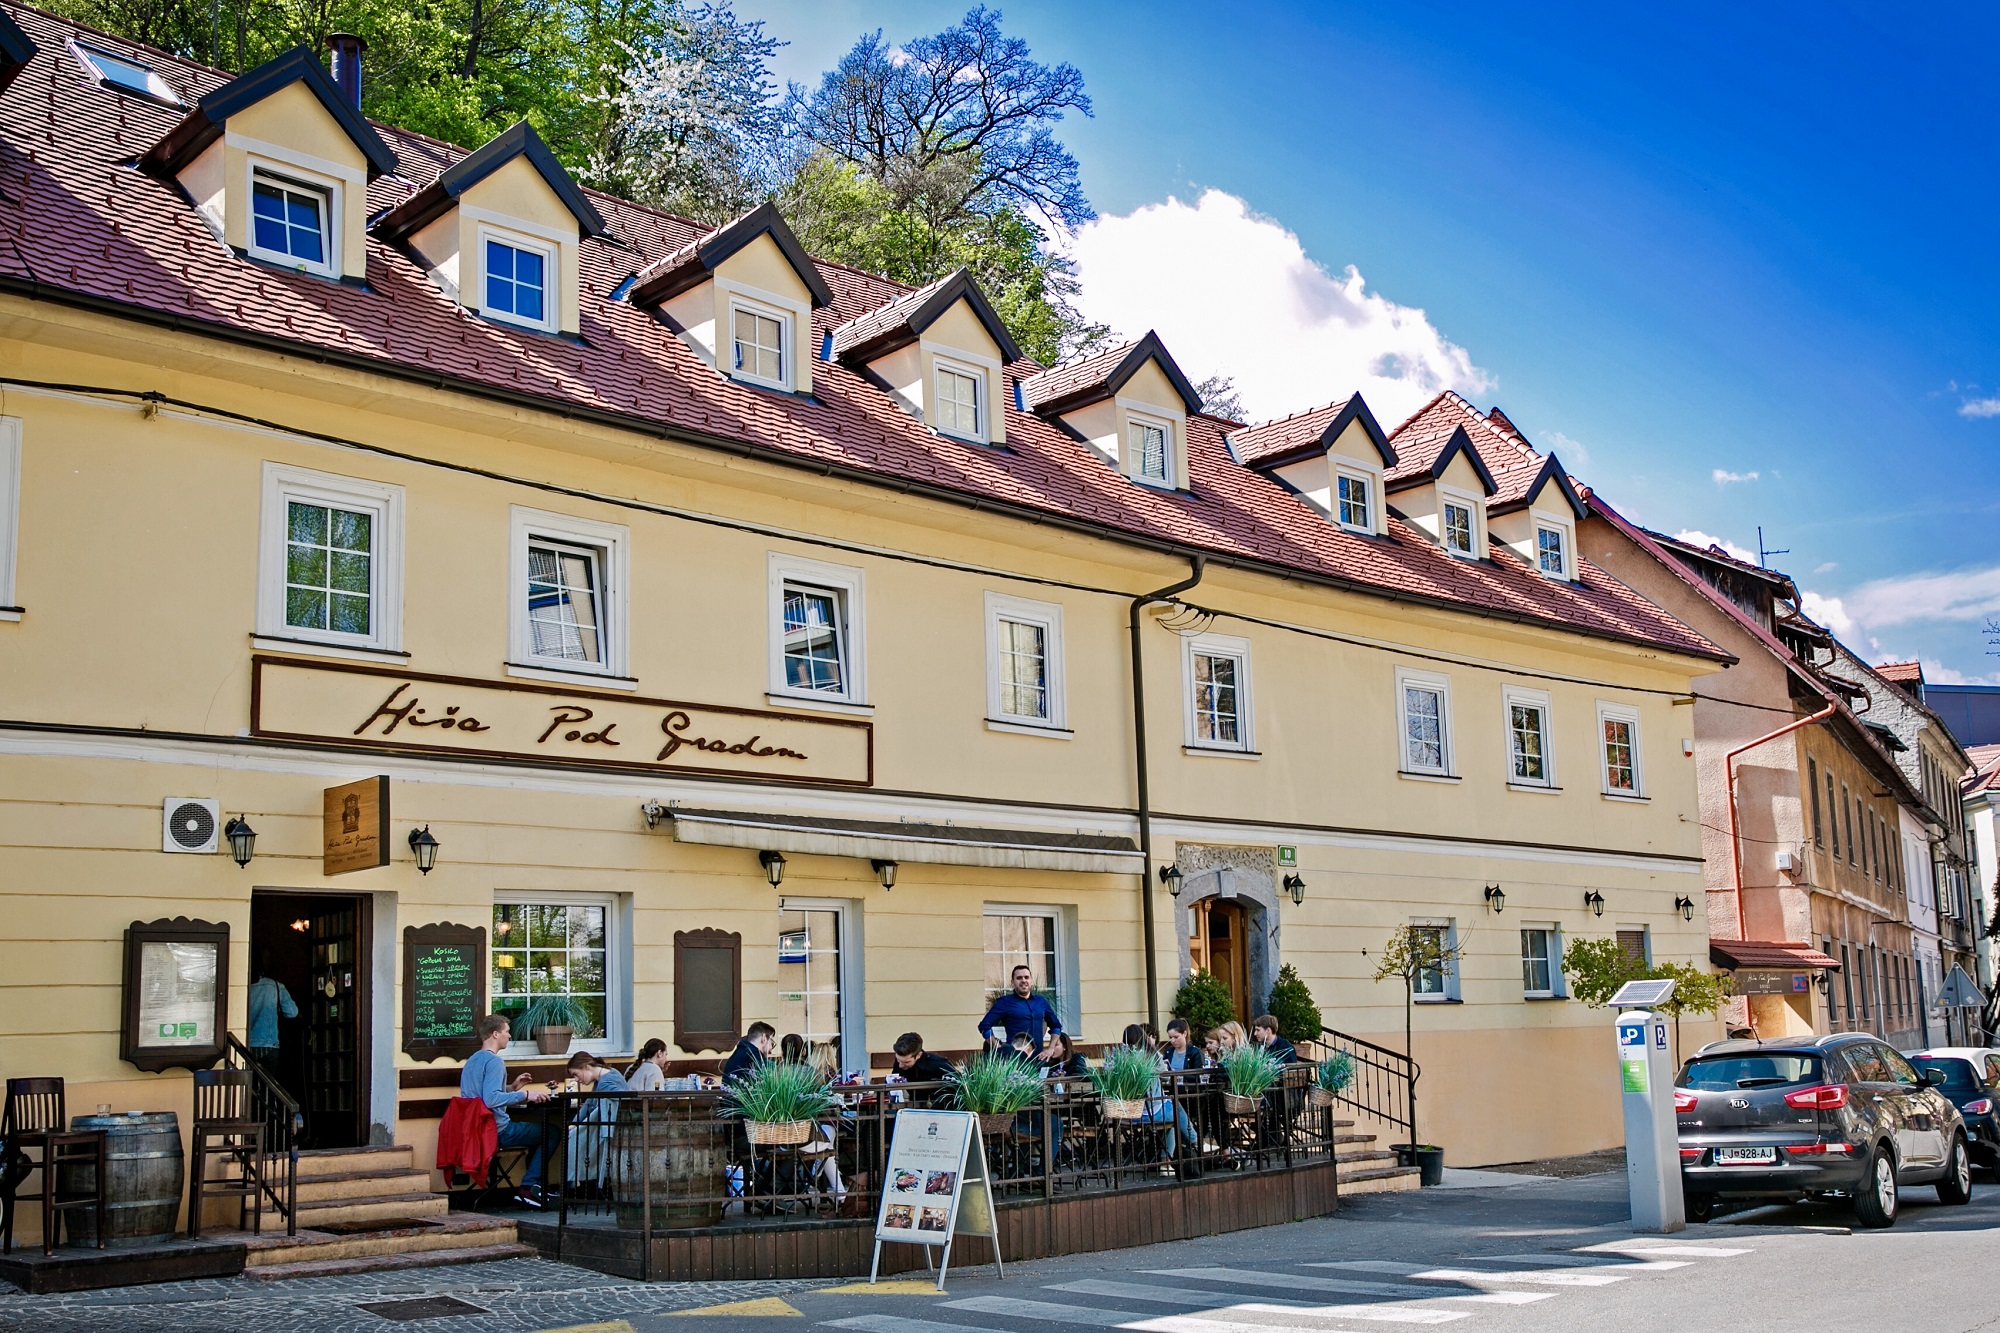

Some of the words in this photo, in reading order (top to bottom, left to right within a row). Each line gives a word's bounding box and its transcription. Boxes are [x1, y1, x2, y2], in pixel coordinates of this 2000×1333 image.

[353, 683, 491, 737] Hiša
[537, 705, 621, 746] Pod
[656, 711, 809, 762] Gradom
[1284, 849, 1292, 859] 10
[1626, 1028, 1638, 1043] P
[1732, 1099, 1747, 1108] KIA
[1740, 1148, 1773, 1159] 928-AJ
